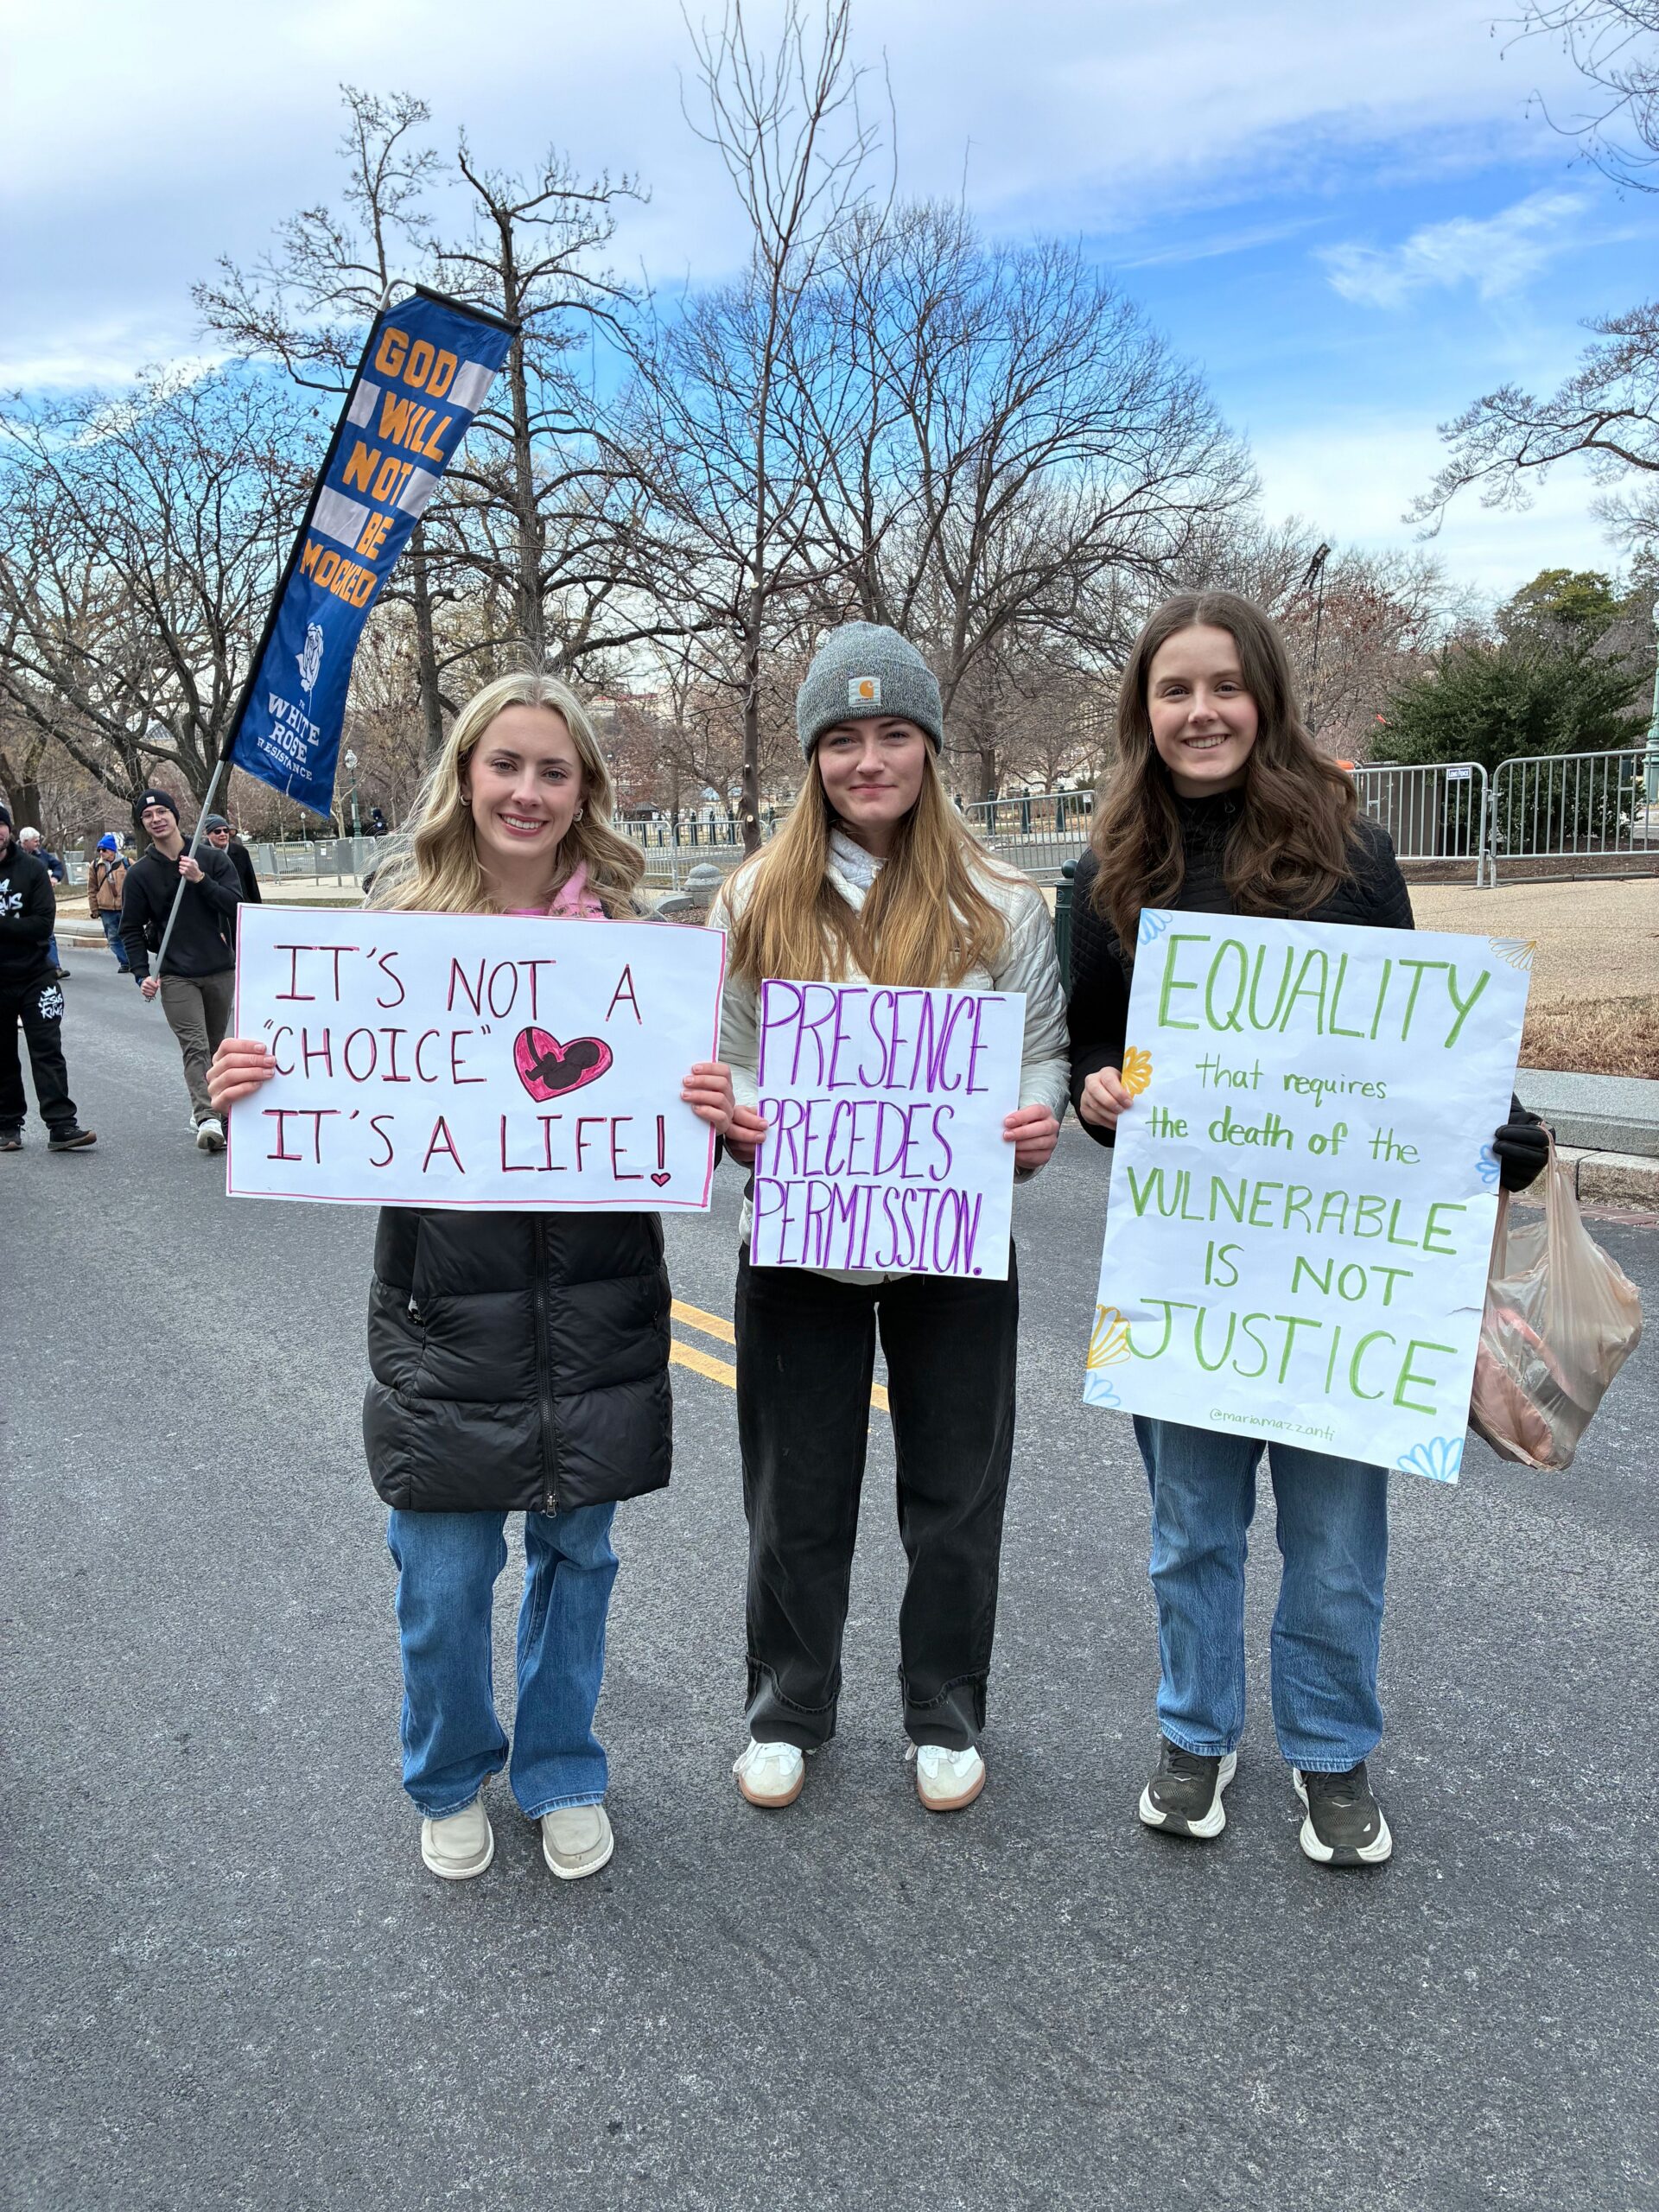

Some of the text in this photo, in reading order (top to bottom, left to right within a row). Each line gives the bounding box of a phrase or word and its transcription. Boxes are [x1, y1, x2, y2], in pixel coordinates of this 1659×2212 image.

[375, 327, 458, 397] GOD
[378, 391, 453, 462] WILL
[342, 440, 414, 506] NOT
[355, 512, 395, 561] BE
[299, 538, 378, 608] MOCKED
[268, 692, 321, 746] WHITE
[269, 721, 308, 764] ROSE
[257, 736, 313, 781] RESISTANCE
[273, 944, 643, 1025] IT'S NOT A
[1158, 934, 1491, 1049] EQUALITY
[758, 979, 1007, 1095] PRESENCE
[1195, 1052, 1387, 1107] that requires
[262, 1109, 671, 1187] IT'S A LIFE!
[755, 1097, 955, 1181] PRECEDES
[1146, 1105, 1421, 1165] the death of the
[752, 1178, 982, 1276] PERMISSION.
[1127, 1166, 1467, 1255] VULNERABLE
[1205, 1241, 1414, 1306] IS NOT
[1125, 1297, 1459, 1416] JUSTICE
[1210, 1408, 1335, 1441] @mariamazzanti
